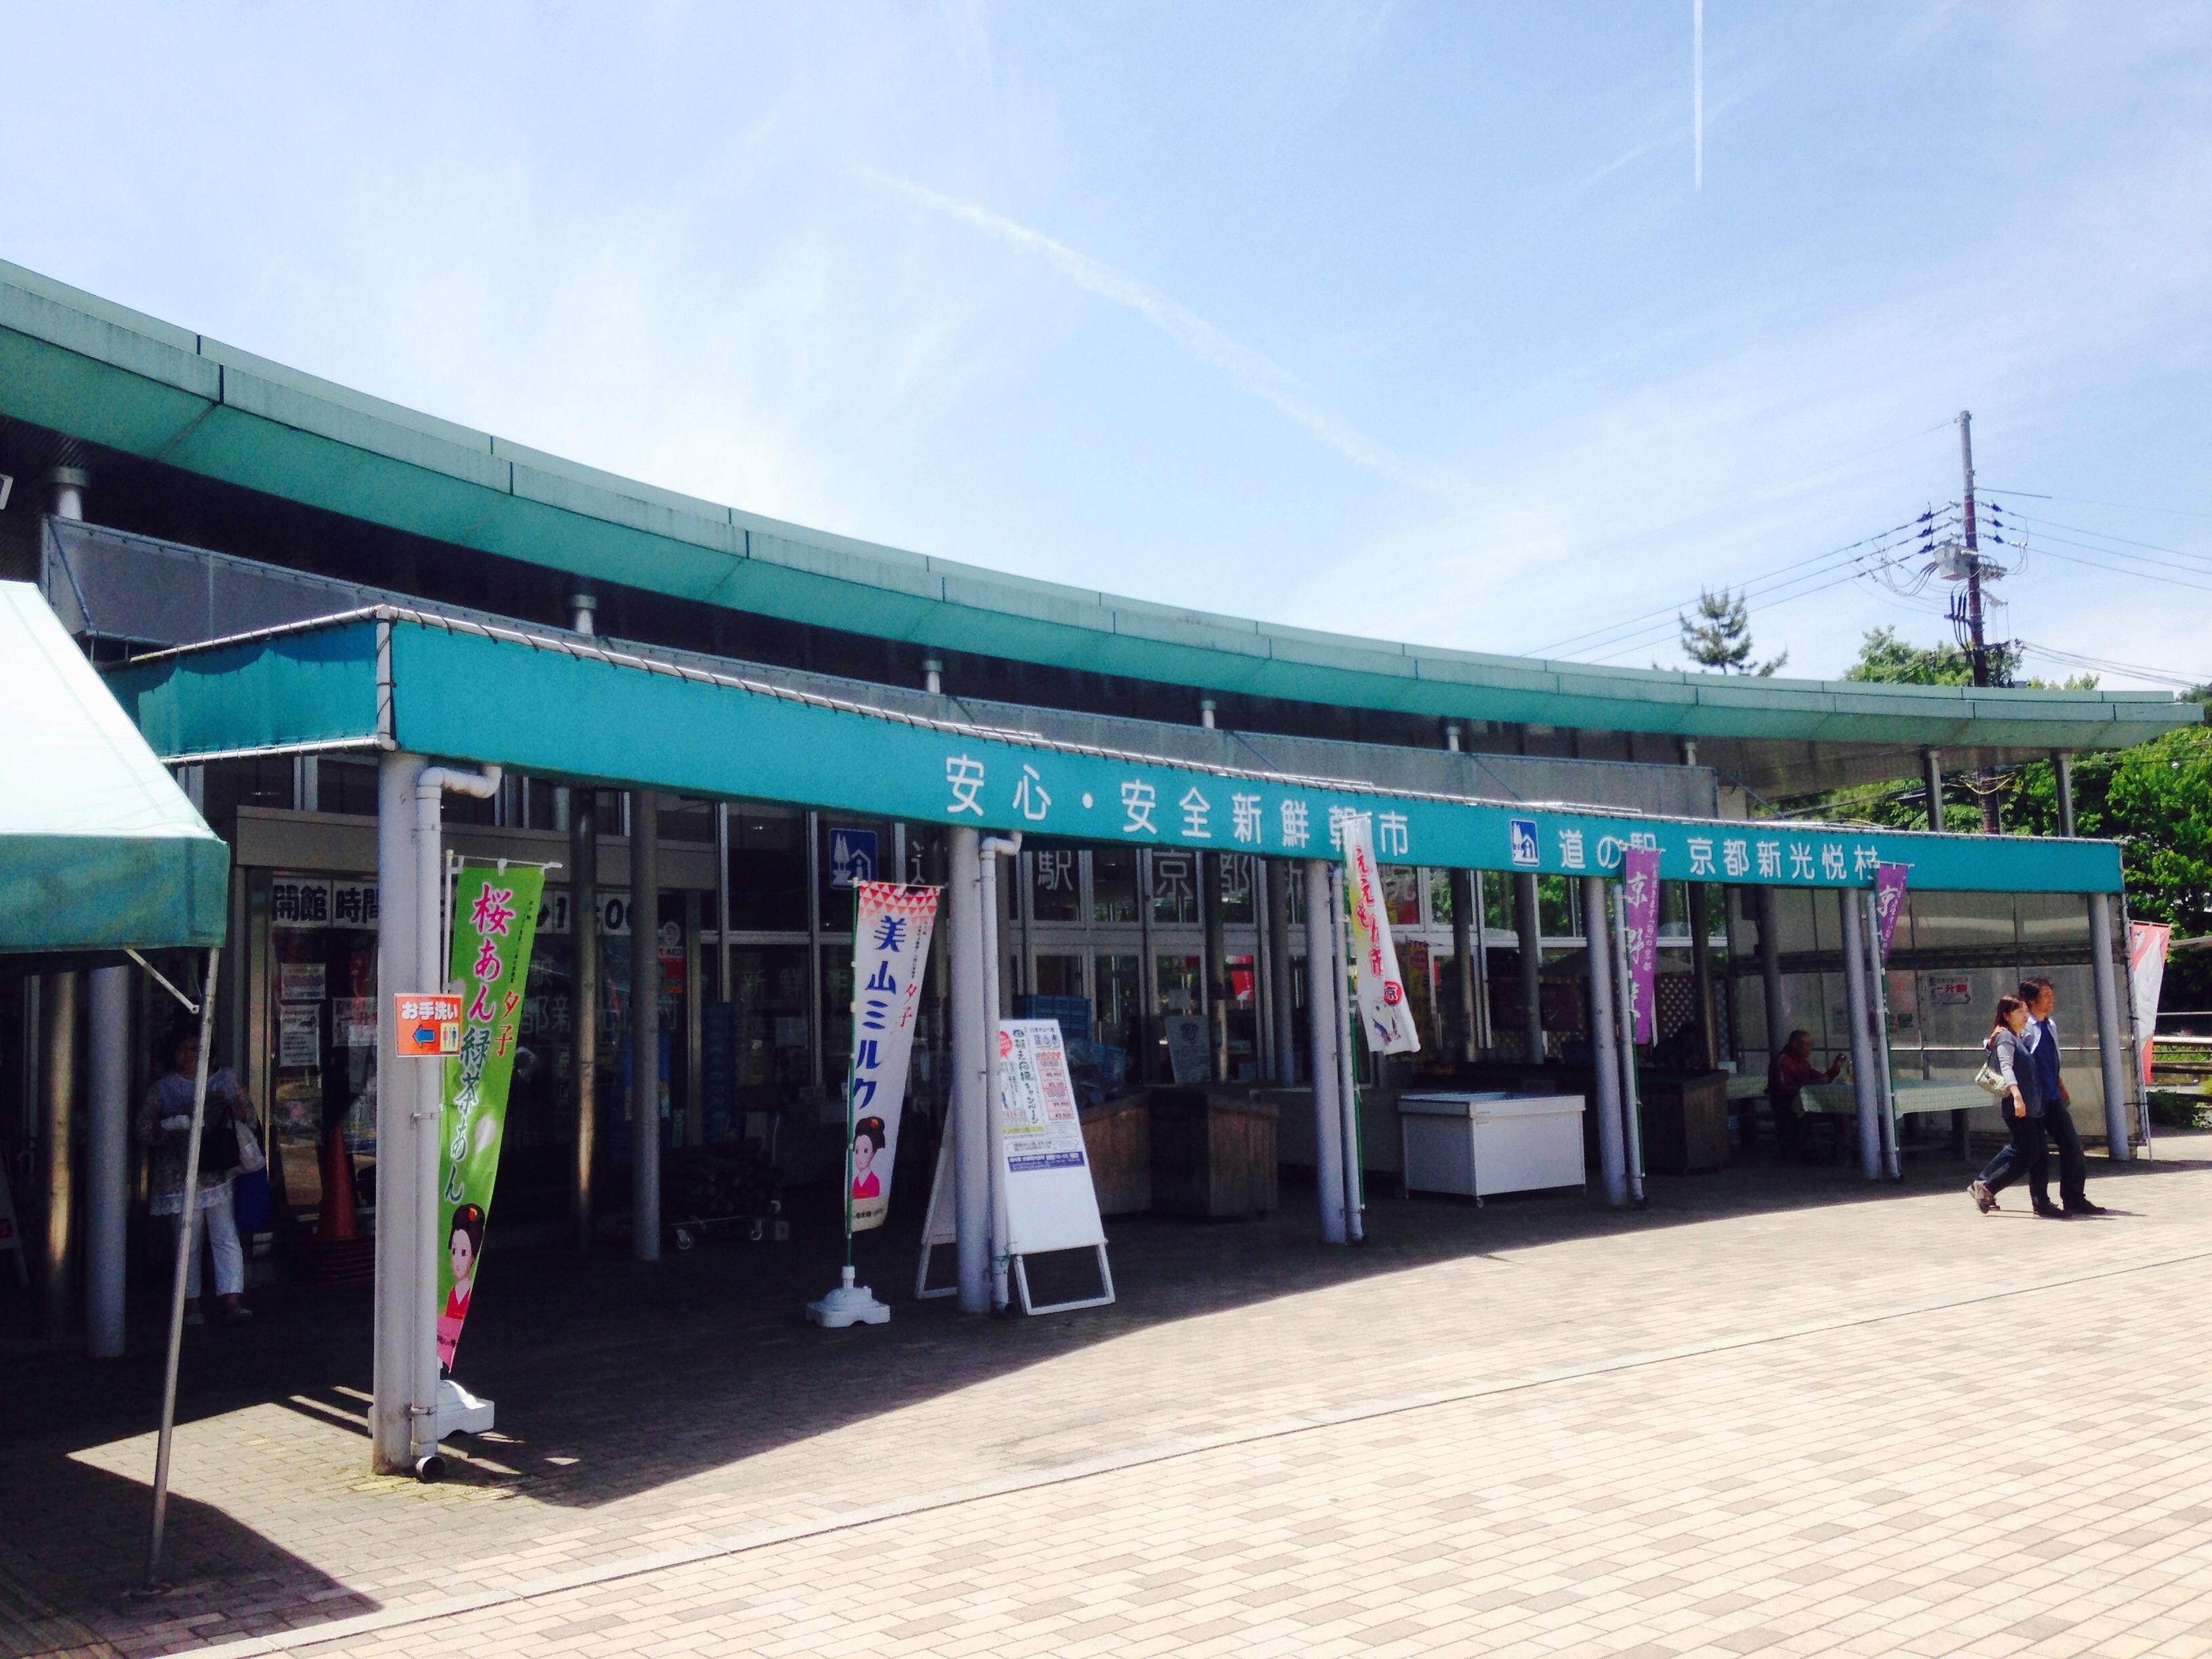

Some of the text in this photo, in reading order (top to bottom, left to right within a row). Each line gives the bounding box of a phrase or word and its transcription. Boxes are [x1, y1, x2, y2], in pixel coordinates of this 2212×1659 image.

[1687, 836, 1878, 881] 京都新光悦村
[401, 1001, 459, 1021] お手洗い
[853, 915, 907, 1109] 美山ミルク
